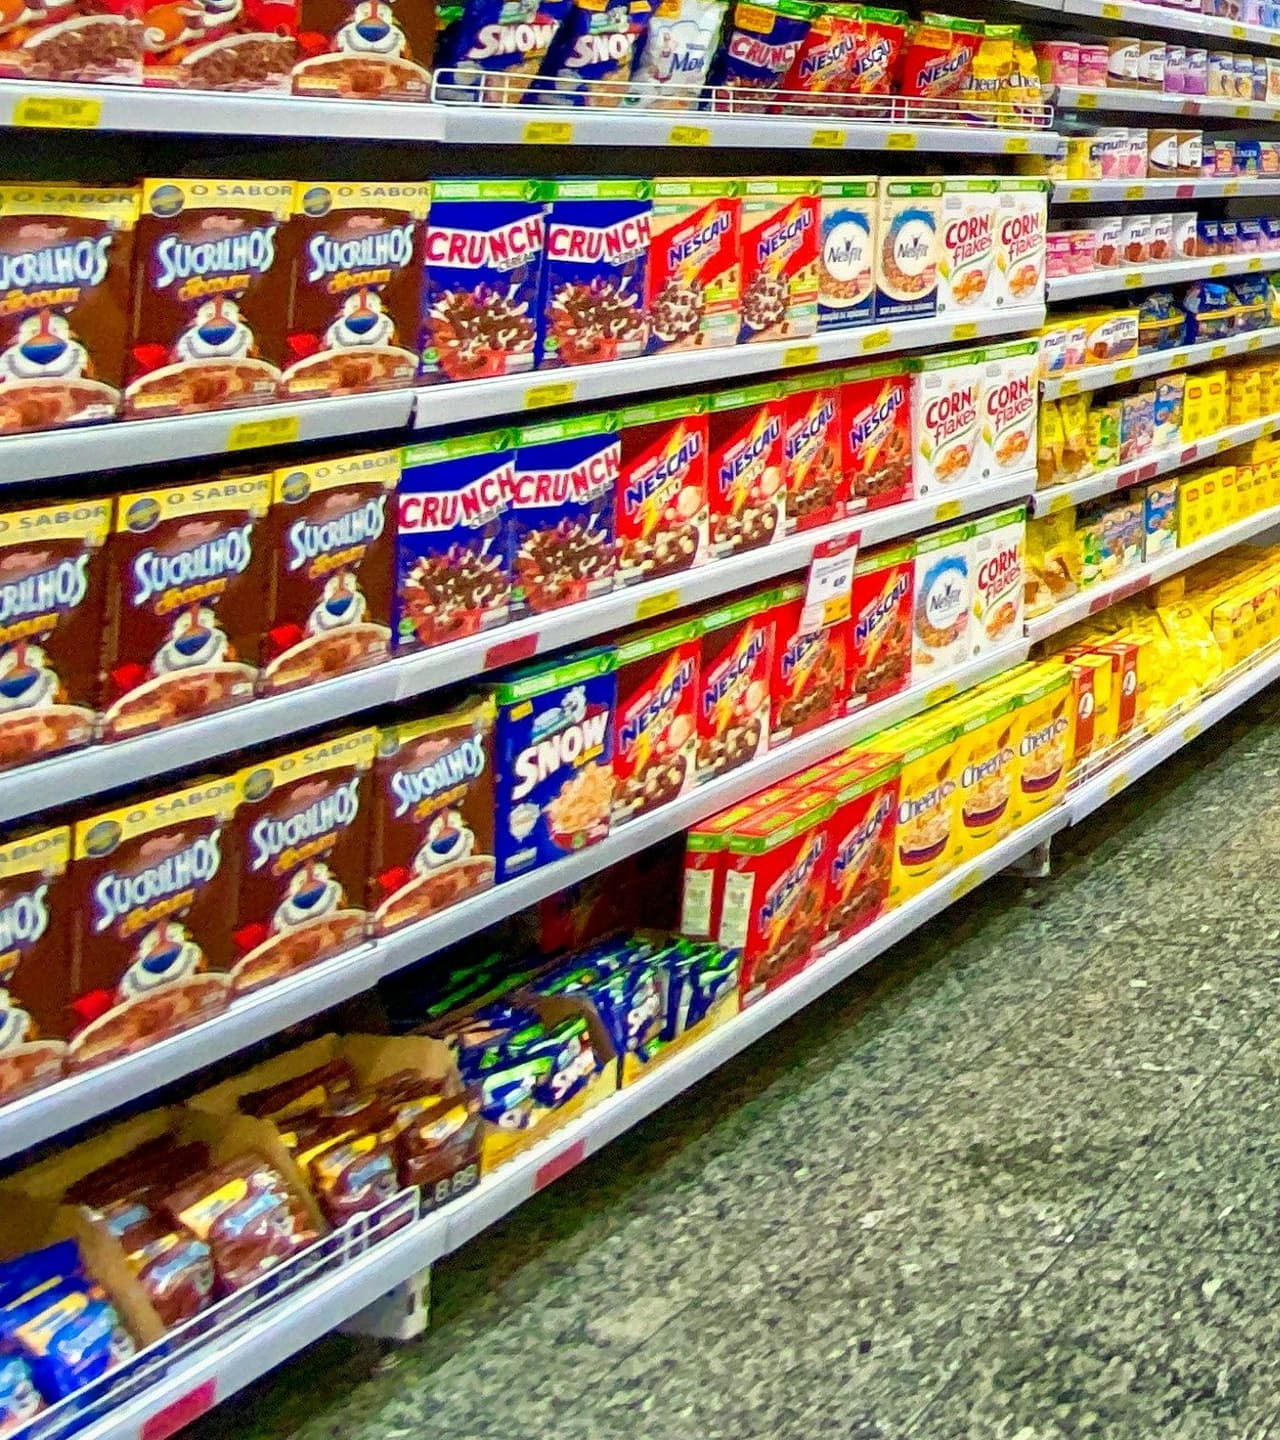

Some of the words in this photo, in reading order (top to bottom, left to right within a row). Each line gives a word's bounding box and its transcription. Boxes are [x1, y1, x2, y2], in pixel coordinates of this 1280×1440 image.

[467, 22, 559, 59] SNOW
[799, 33, 855, 78] NESCAU
[917, 47, 973, 87] NESCAU
[14, 192, 35, 203] O
[51, 192, 134, 204] SABOR
[190, 185, 209, 196] O
[216, 185, 292, 197] SABOR
[338, 186, 354, 197] O
[359, 186, 429, 197] SABOR
[425, 218, 543, 264] CRUNCH
[548, 215, 650, 259] CRUNCH
[668, 212, 730, 269] NESCAU
[757, 208, 813, 261] NESCAU
[945, 215, 991, 249] CORN
[1001, 213, 1040, 245] CORN
[0, 236, 112, 287] UCRILHOS
[157, 227, 277, 288] SUCRILHOS
[309, 225, 414, 282] SUCRILHOS
[926, 387, 971, 429] CORN
[987, 376, 1029, 416] CORN
[851, 388, 903, 450] NESCAU
[315, 466, 330, 478] O
[337, 452, 399, 476] SABOR
[625, 432, 701, 513] NESCAU
[721, 417, 781, 489] NESCAU
[167, 492, 185, 505] O
[192, 478, 271, 503] SABOR
[401, 467, 517, 529] CRUNCH
[514, 448, 620, 504] CRUNCH
[20, 505, 107, 528] SABOR
[289, 496, 386, 571] SUCRILHOS
[134, 524, 253, 606] SUCRILHOS
[978, 545, 1018, 590] CORN
[855, 574, 909, 645] NESCAU
[304, 734, 375, 765] SABOR
[512, 711, 610, 800] SNOW
[1019, 715, 1069, 757] Cheerios
[961, 749, 1015, 788] Cheerios
[155, 783, 235, 816] SABOR
[251, 777, 361, 871] SUCRILHOS
[94, 828, 222, 932] SUCRILHOS
